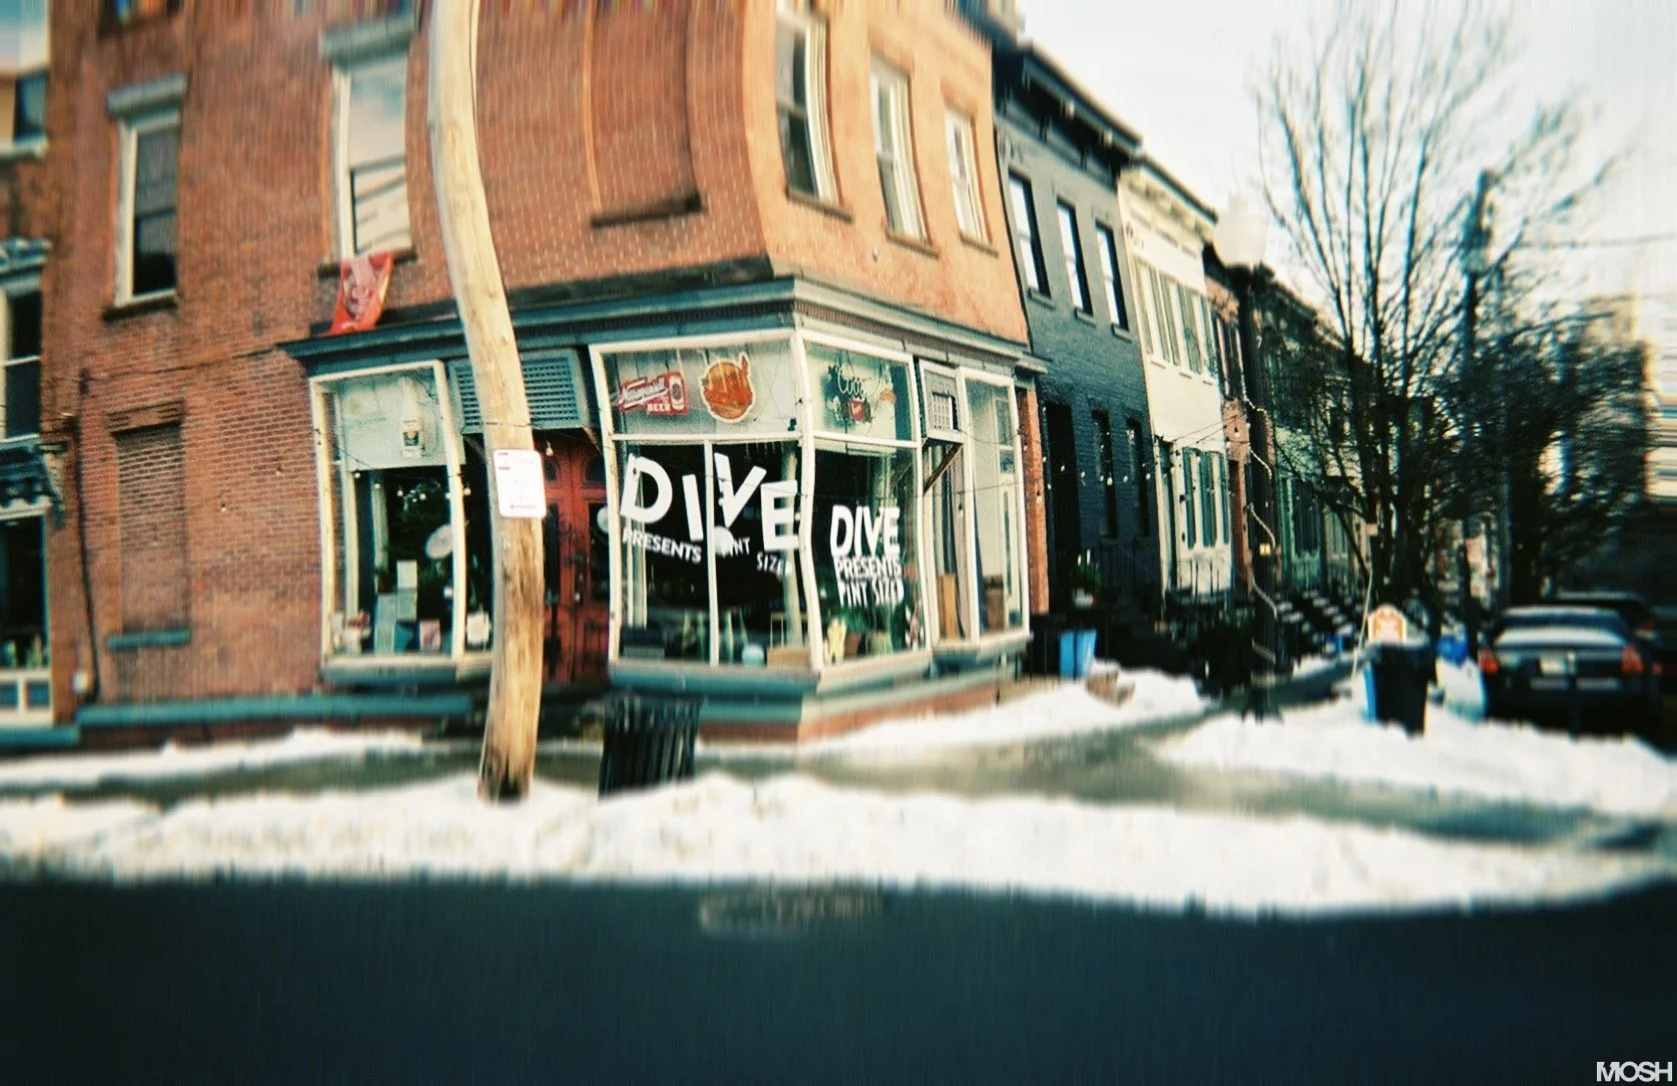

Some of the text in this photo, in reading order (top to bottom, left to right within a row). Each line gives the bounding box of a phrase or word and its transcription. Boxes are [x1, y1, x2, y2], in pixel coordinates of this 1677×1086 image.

[647, 402, 671, 413] BEER
[620, 452, 800, 551] DIVE
[622, 526, 702, 564] PRESENTS
[830, 504, 901, 557] DIVE
[833, 555, 902, 580] PRESENTS
[838, 579, 868, 608] PINT
